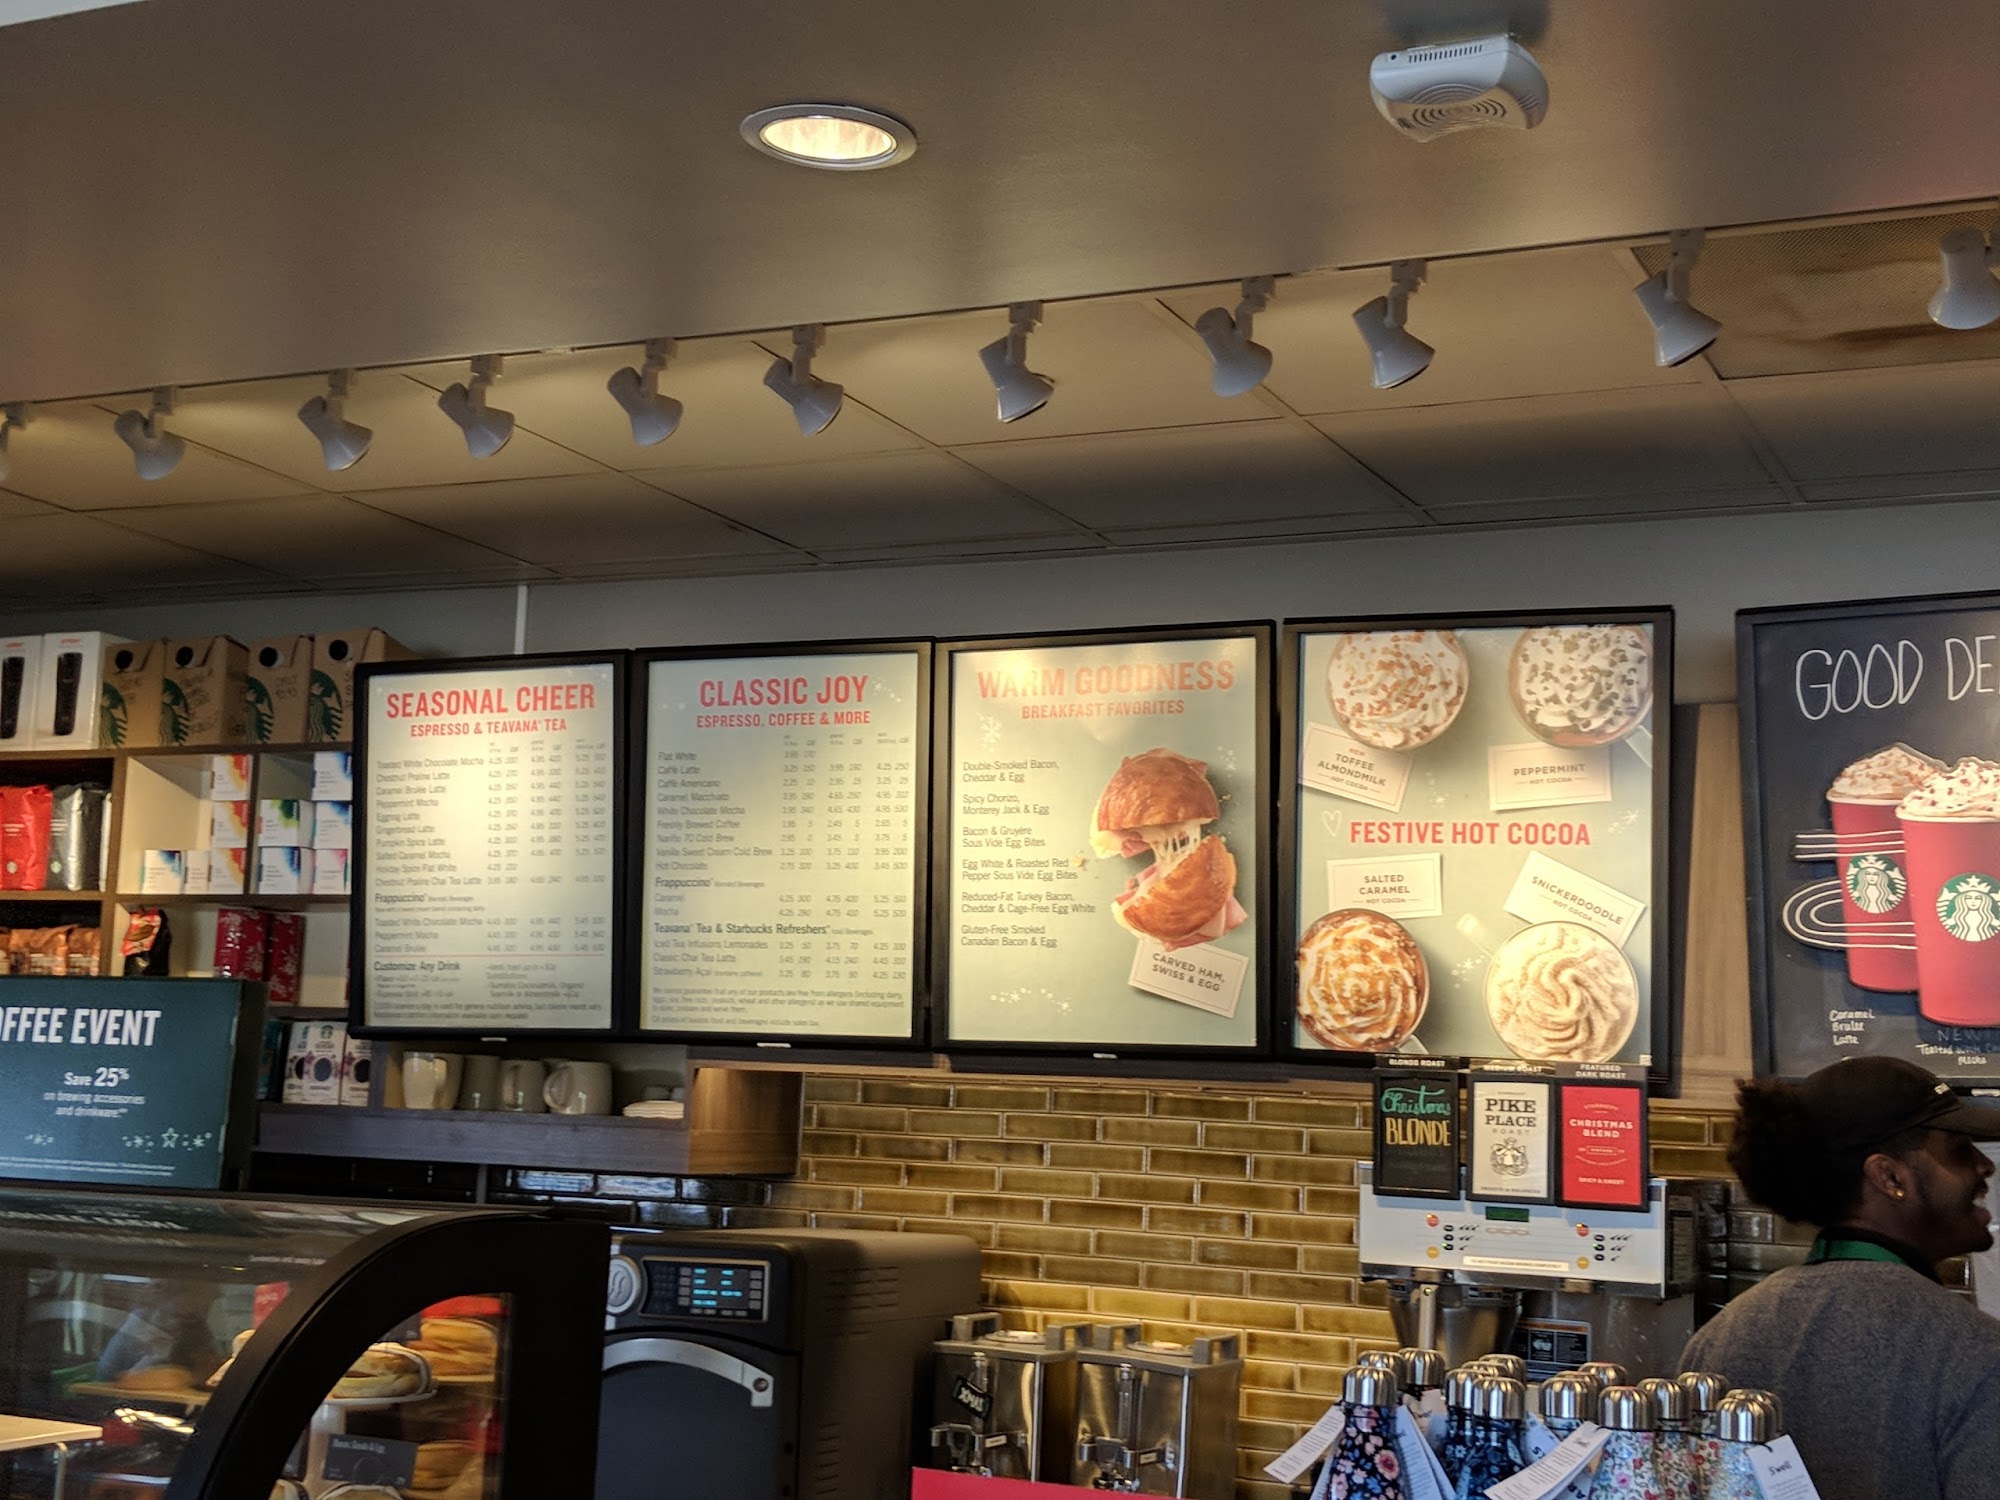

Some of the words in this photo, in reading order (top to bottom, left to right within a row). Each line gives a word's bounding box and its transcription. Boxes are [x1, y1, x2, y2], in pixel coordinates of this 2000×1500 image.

[977, 667, 1065, 698] WARM
[1075, 660, 1235, 695] GOODNESS
[1796, 640, 1924, 720] GOOD
[1945, 635, 2000, 701] DE
[700, 678, 807, 707] CLASSIC
[817, 675, 869, 704] JOY
[387, 688, 508, 718] SEASONAL
[517, 684, 595, 712] CHEER
[1021, 704, 1104, 719] BREAKFAST
[1107, 700, 1184, 716] FAVORITES
[697, 715, 765, 728] ESPRESSO,
[769, 713, 815, 726] COFFEE
[821, 713, 829, 725] &
[834, 711, 871, 725] MORE
[411, 723, 469, 736] ESPRESSO
[474, 724, 482, 734] &
[545, 719, 567, 730] TEA
[425, 758, 458, 767] Chocolate
[460, 757, 483, 766] Mocha
[658, 752, 673, 761] Flat
[675, 751, 696, 761] White
[1336, 753, 1375, 771] TOFFEE
[680, 766, 700, 774] Latte
[963, 760, 1028, 771] Double-Smoked
[1030, 760, 1059, 769] Bacon,
[1514, 764, 1586, 776] PEPPERMINT
[963, 773, 996, 782] Cheddar
[999, 773, 1006, 781] &
[1009, 773, 1024, 783] Egg
[1317, 760, 1386, 787] ALMONDMILK
[1331, 776, 1345, 785] HOT
[1346, 779, 1368, 791] COCOA
[1547, 776, 1573, 784] COCOA
[963, 794, 985, 804] Spicy
[987, 794, 1018, 803] Chorizo,
[657, 807, 678, 815] White
[680, 806, 717, 815] Chocolate
[719, 806, 744, 815] Mocha
[963, 804, 1000, 816] Monterey
[1003, 805, 1021, 814] Jack
[1023, 805, 1030, 813] &
[1033, 804, 1049, 816] Egg
[963, 826, 988, 836] Bacon
[991, 826, 998, 835] &
[1000, 825, 1032, 837] Gruyère
[1351, 822, 1443, 843] FESTIVE
[1452, 822, 1499, 844] HOT
[1508, 823, 1591, 845] COCOA
[963, 838, 981, 847] Sous
[984, 837, 1003, 847] Vide
[1006, 837, 1022, 848] Egg
[1025, 837, 1045, 847] Bites
[753, 847, 772, 856] Brew
[963, 859, 978, 869] Egg
[980, 859, 1004, 868] White
[1007, 859, 1013, 868] &
[1016, 859, 1049, 868] Roasted
[1052, 859, 1068, 867] Red
[962, 870, 991, 881] Pepper
[994, 870, 1014, 880] Sous
[1017, 870, 1034, 880] Vide
[1037, 870, 1053, 881] Egg
[1057, 870, 1078, 880] Bites
[1364, 874, 1405, 884] SALTED
[1360, 885, 1410, 895] CARAMEL
[962, 892, 1014, 901] Reduced-Fat
[1017, 892, 1044, 903] Turkey
[1046, 892, 1075, 902] Bacon,
[1532, 877, 1624, 925] SNICKERDOODLE
[961, 903, 995, 913] Cheddar
[998, 904, 1004, 913] &
[1008, 903, 1049, 914] Cage-Free
[1052, 903, 1069, 914] Egg
[1071, 903, 1095, 913] White
[1553, 900, 1567, 909] HOT
[1568, 907, 1592, 922] COCOA
[696, 923, 712, 934] Tea
[716, 924, 723, 933] &
[726, 923, 773, 934] Starbucks
[961, 925, 1008, 934] Gluten-Free
[1011, 925, 1045, 934] Smoked
[961, 936, 999, 946] Canadian
[1002, 937, 1028, 946] Bacon
[1031, 937, 1037, 946] &
[1041, 937, 1057, 948] Egg
[374, 961, 416, 971] Customize
[420, 961, 435, 972] Any
[437, 961, 460, 970] Drink
[1152, 953, 1195, 971] CARVED
[1198, 967, 1225, 983] HAM,
[1152, 964, 1185, 981] SWISS
[1198, 978, 1220, 992] EGG
[1829, 1009, 1875, 1021] Caramel
[70, 1008, 161, 1046] EVENT
[1576, 1070, 1597, 1078] DARK
[1580, 1064, 1622, 1072] FEATURED
[64, 1072, 92, 1086] Save
[94, 1067, 130, 1087] 25%
[43, 1092, 55, 1100] on
[57, 1092, 91, 1104] brewing
[94, 1094, 145, 1104] accessories
[56, 1107, 74, 1115] and
[1485, 1098, 1536, 1114] PIKE
[1485, 1114, 1536, 1128] PLACE
[1569, 1118, 1633, 1130] CHRISTMAS
[1386, 1118, 1451, 1146] BLONDE
[1492, 1128, 1530, 1136] ROAST
[1582, 1128, 1620, 1138] BLEND
